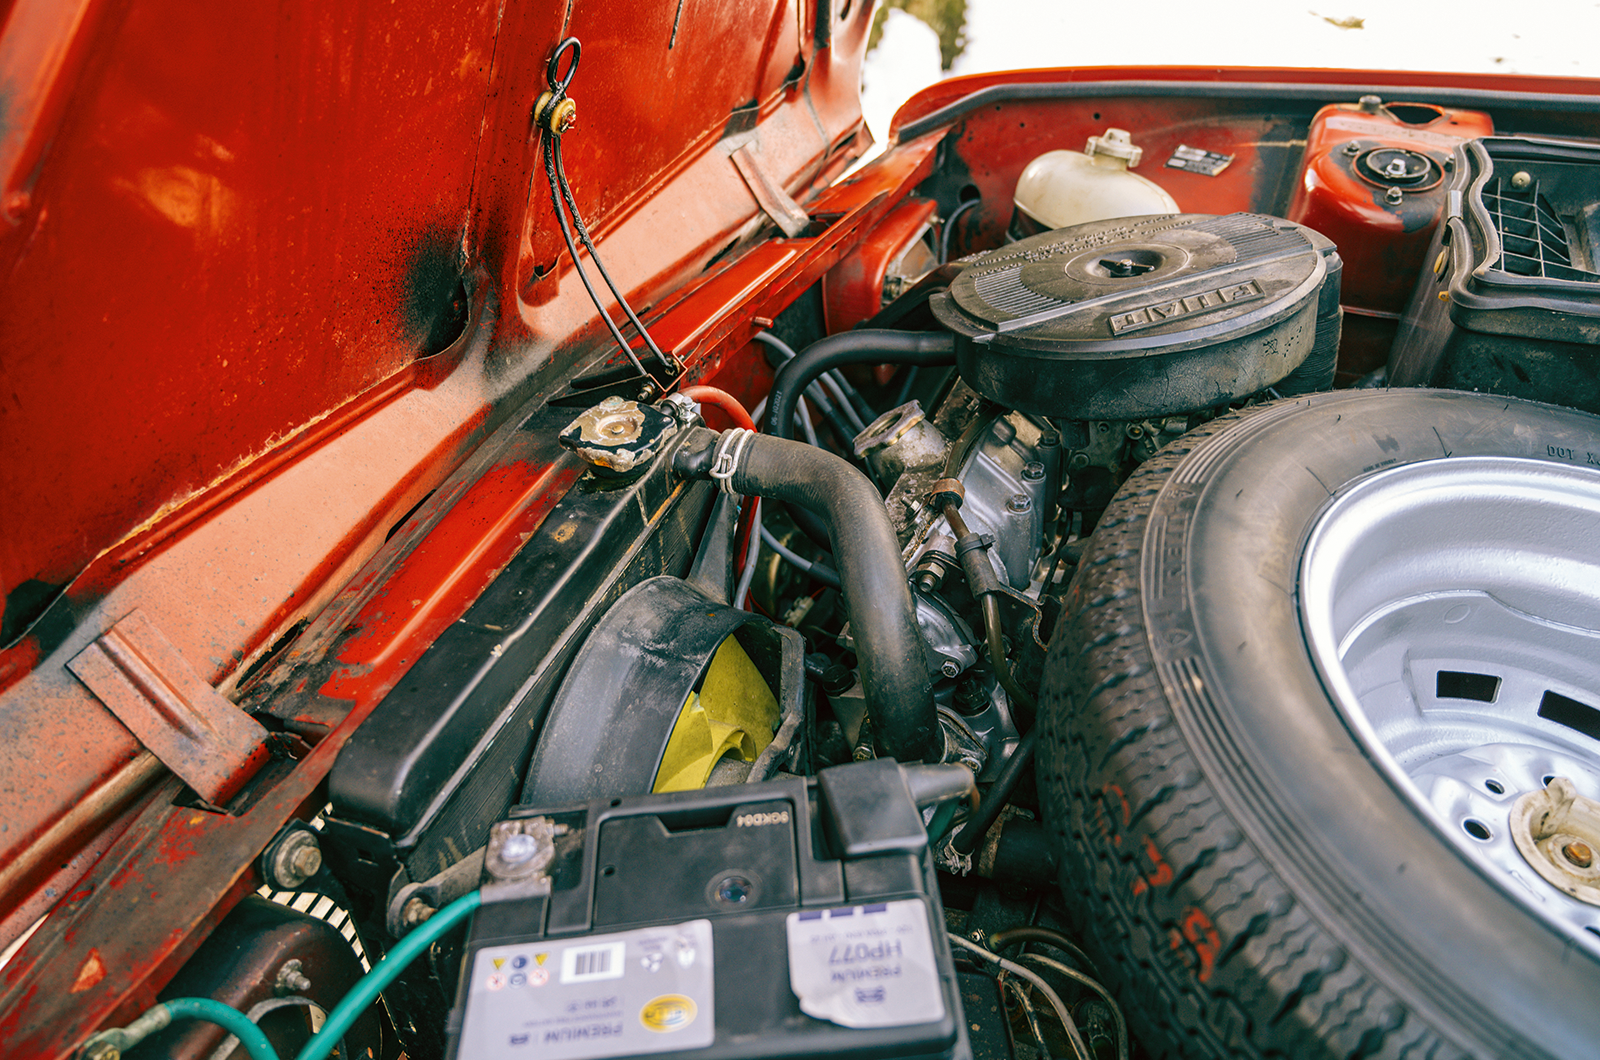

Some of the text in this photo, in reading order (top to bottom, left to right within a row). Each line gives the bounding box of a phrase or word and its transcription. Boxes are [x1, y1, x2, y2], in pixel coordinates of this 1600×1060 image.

[1120, 283, 1254, 331] FIAT
[1546, 444, 1575, 460] DOT
[828, 938, 904, 966] HP077
[830, 964, 903, 983] PREMIUM
[544, 1022, 625, 1044] PREMIUM
